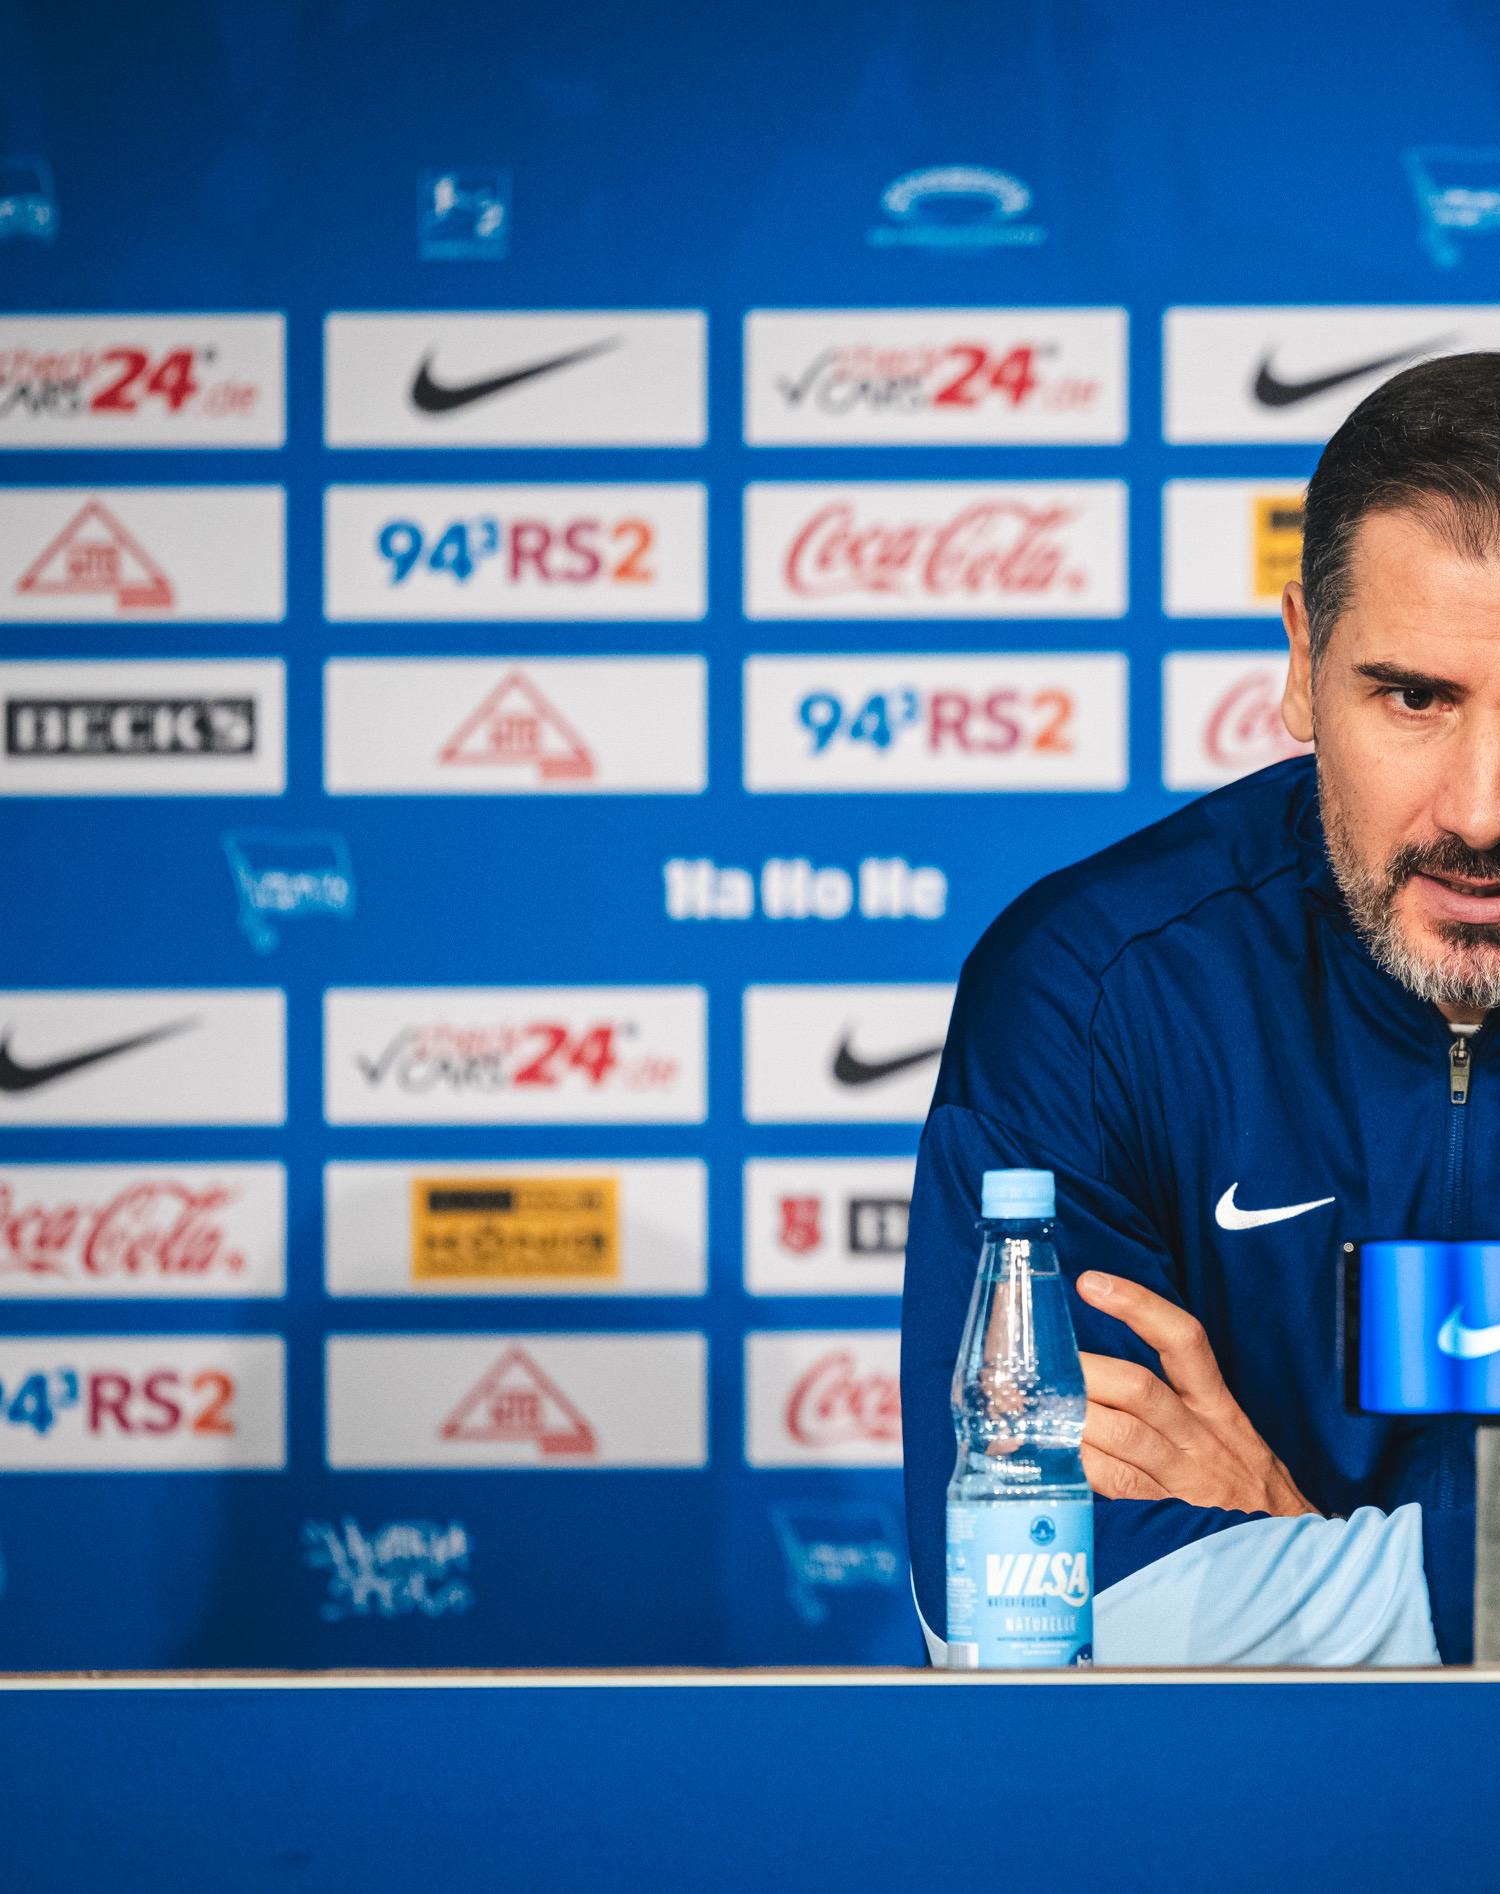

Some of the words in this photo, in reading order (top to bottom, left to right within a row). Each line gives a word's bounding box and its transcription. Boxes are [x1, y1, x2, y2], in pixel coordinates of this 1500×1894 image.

[89, 346, 194, 411] 24
[933, 344, 1038, 409] 24
[783, 500, 1083, 596] Coca-Cola
[664, 858, 756, 920] Ha
[761, 858, 853, 920] Ho
[859, 858, 947, 920] He
[513, 1023, 618, 1088] 24
[986, 1551, 1091, 1608] VILSA
